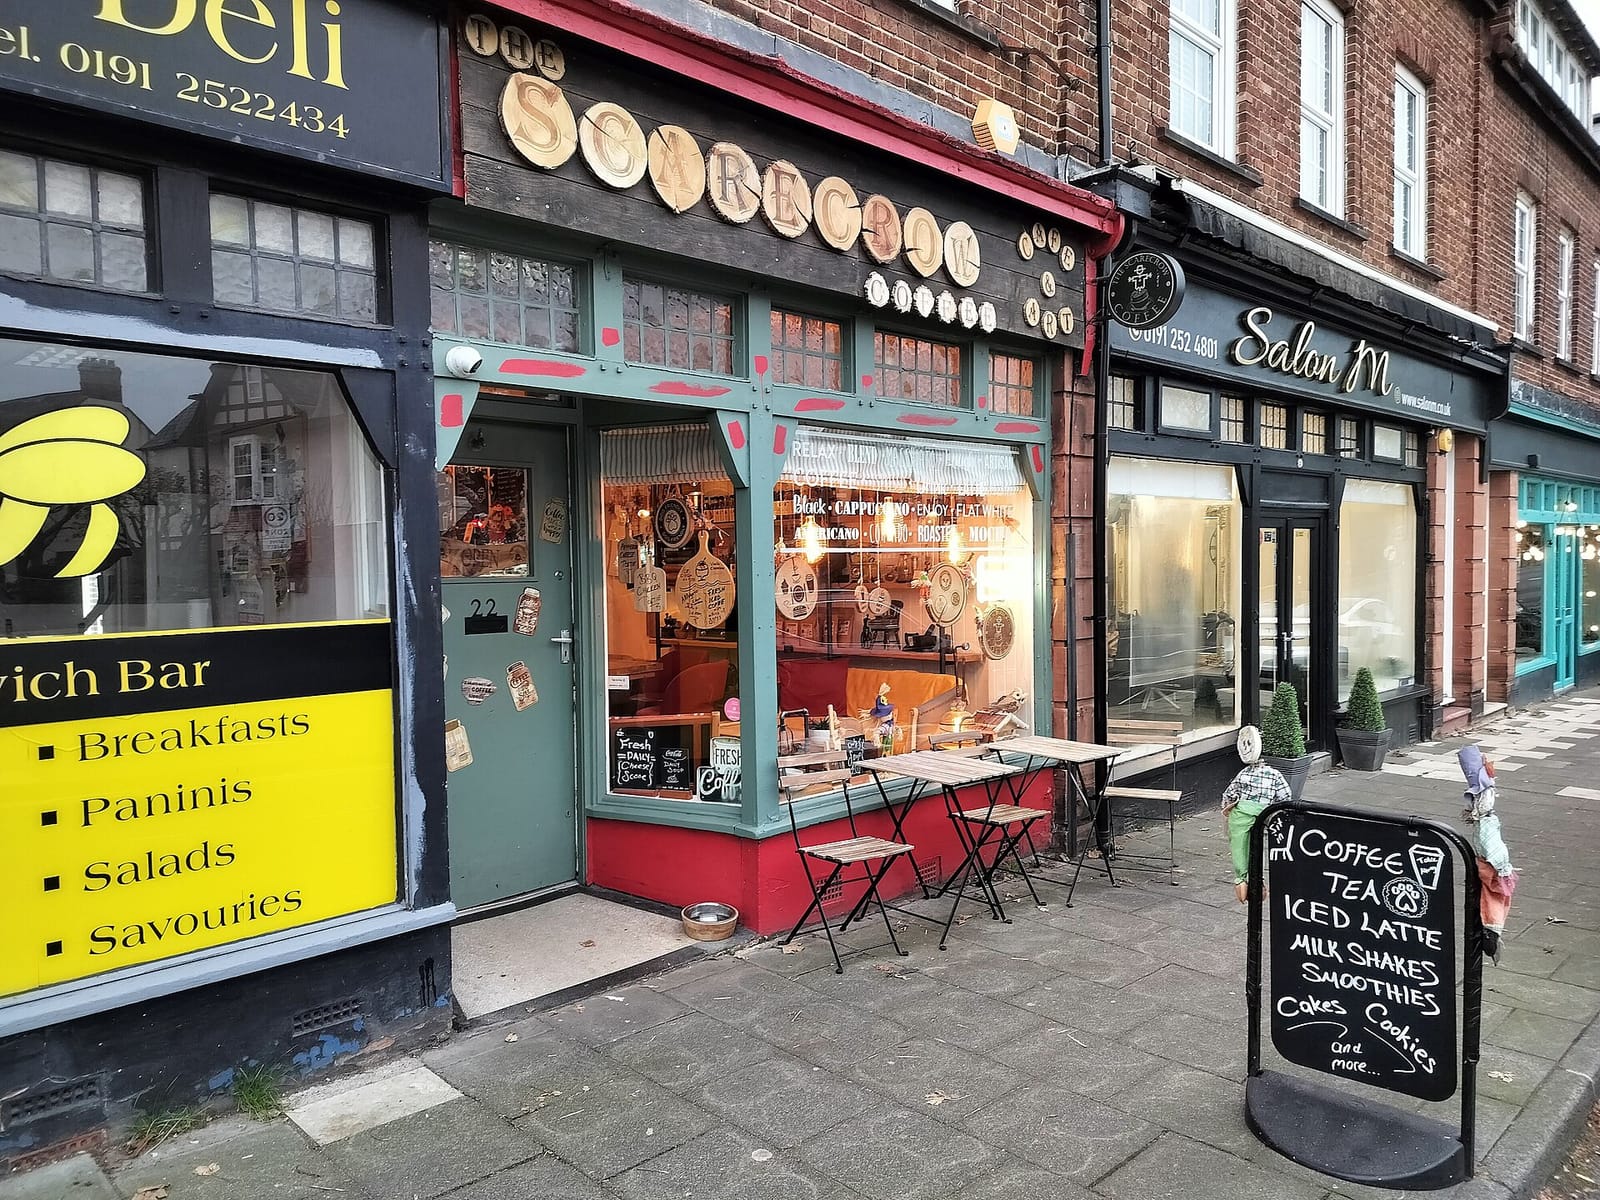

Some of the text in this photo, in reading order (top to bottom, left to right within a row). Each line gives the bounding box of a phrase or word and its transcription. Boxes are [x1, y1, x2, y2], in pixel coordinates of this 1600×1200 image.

[469, 20, 560, 75] THE
[60, 43, 153, 91] 0191
[176, 73, 349, 138] 2522434
[509, 76, 974, 280] SCARECROW
[1020, 225, 1074, 270] CAFE
[1124, 255, 1170, 277] SCARECROW
[867, 275, 995, 333] COFFEE
[1026, 301, 1072, 336] ART
[1114, 295, 1168, 324] COFFEE
[1143, 326, 1218, 359] 0191 252 4801
[1233, 306, 1393, 396] Salon M
[792, 440, 836, 460] RELAX
[847, 443, 877, 465] BLEND
[793, 493, 826, 514] Black
[956, 503, 980, 518] FLAT
[470, 598, 499, 617] 22
[117, 660, 211, 693] Bar
[78, 713, 310, 762] Breakfasts
[619, 738, 651, 751] Fresh
[627, 751, 650, 761] DAILY
[82, 778, 252, 828] Paninis
[83, 841, 237, 893] Salads
[1323, 871, 1381, 905] TEA
[89, 889, 303, 956] Savouries
[1285, 895, 1442, 950] ICED LATTE
[1290, 934, 1440, 986] MILK SHAKES
[1302, 962, 1441, 1015] SMOOTHIES
[1277, 995, 1436, 1074] Cakes Cookies
[1331, 1040, 1363, 1055] and
